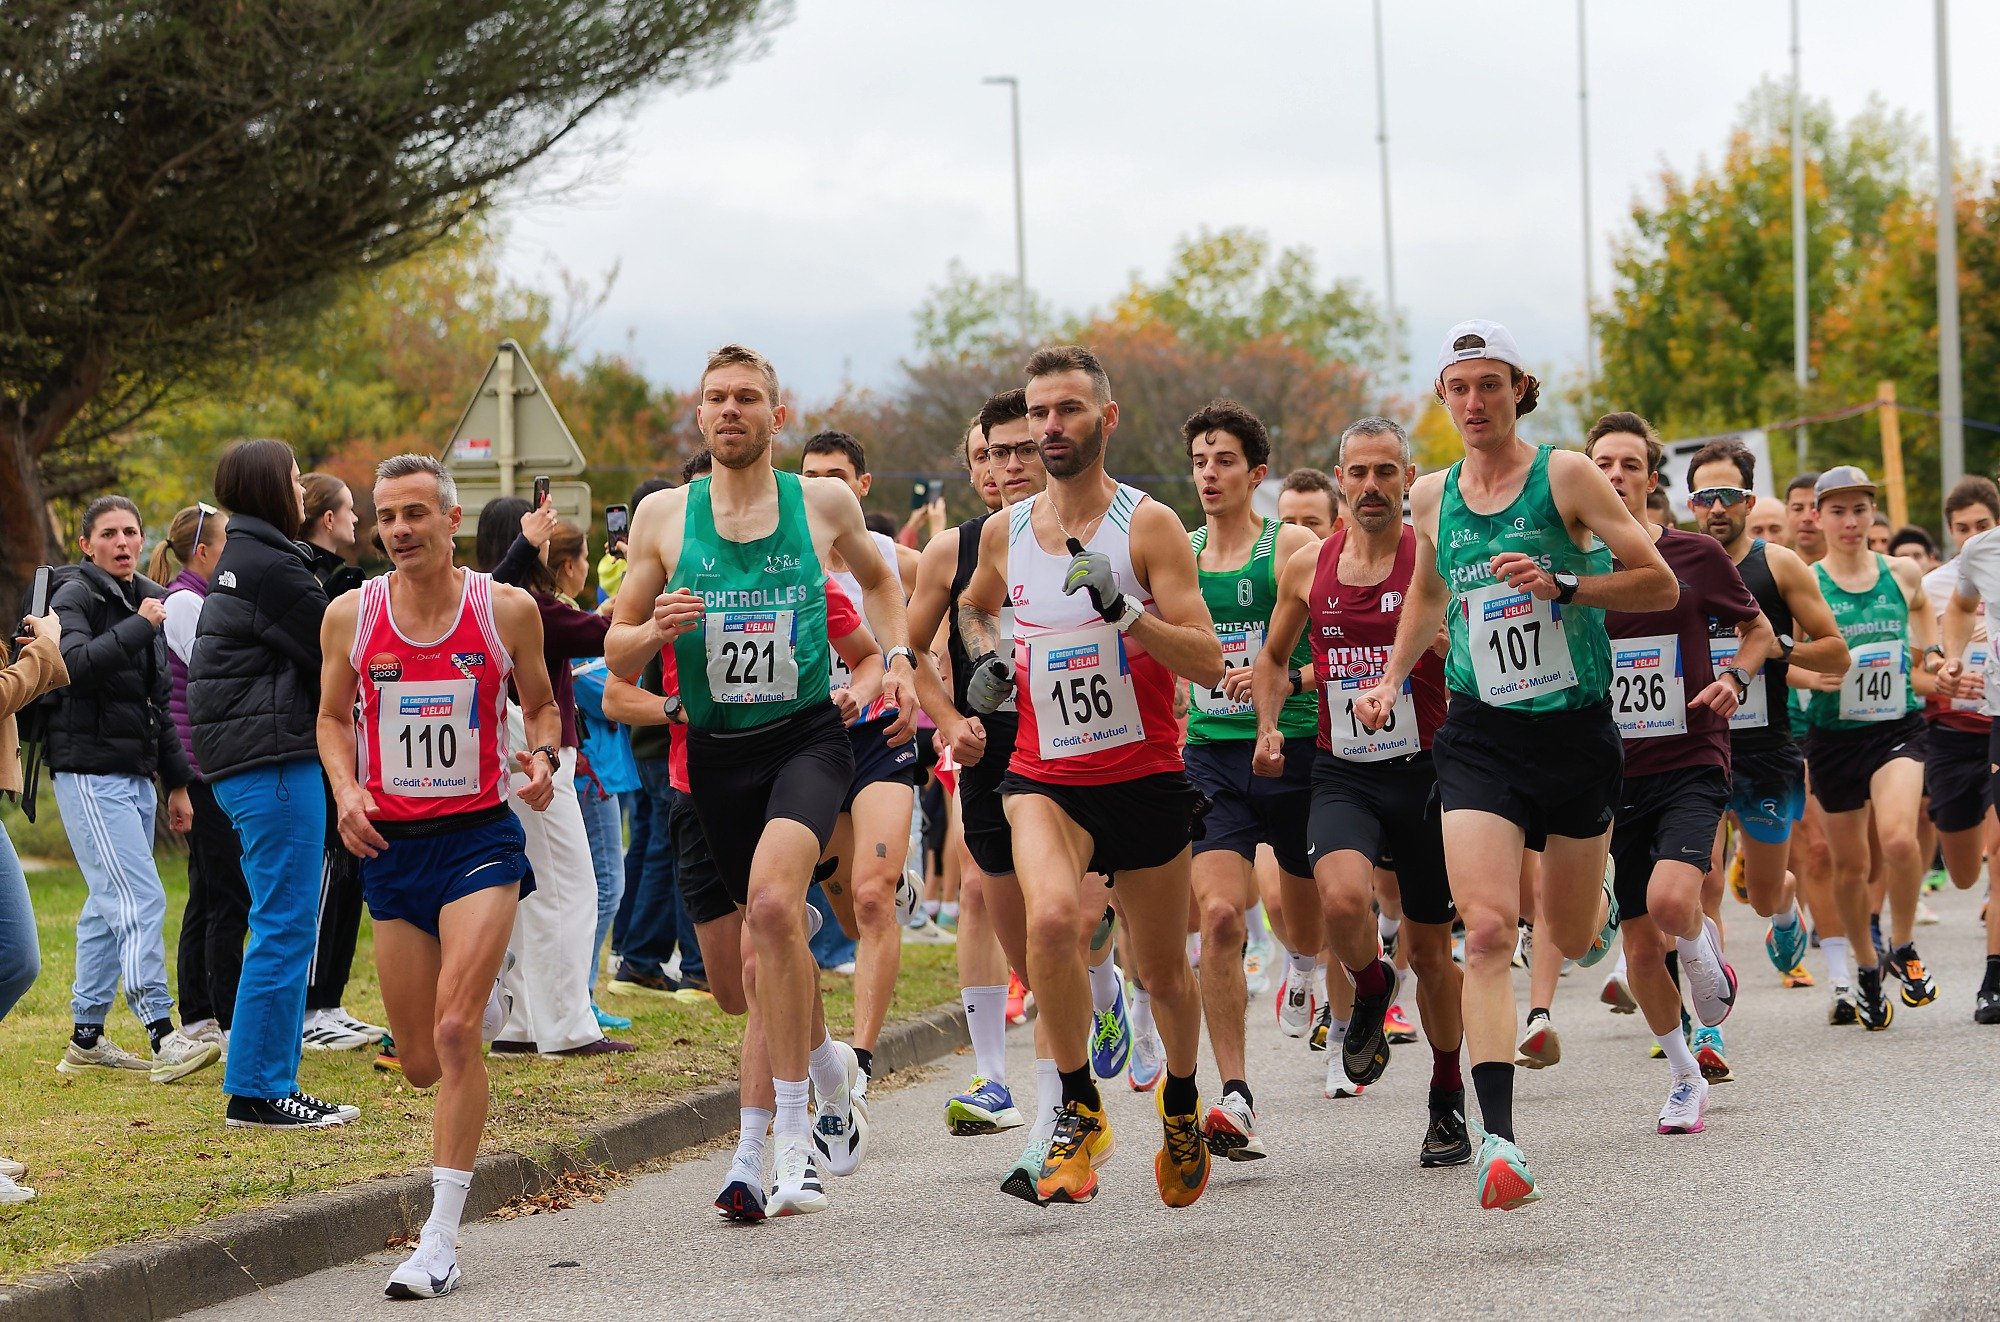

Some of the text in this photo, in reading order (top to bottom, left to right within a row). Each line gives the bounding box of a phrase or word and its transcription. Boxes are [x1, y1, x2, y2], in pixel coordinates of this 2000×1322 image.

[1491, 600, 1509, 609] CRÉDIT
[1510, 594, 1531, 605] MUTUEL
[1485, 603, 1531, 620] DONNE L'ÉLAN
[745, 622, 774, 632] L'ÉLAN
[1056, 650, 1074, 659] CRÉDIT
[1075, 646, 1097, 656] MUTUEL
[1223, 642, 1245, 652] L'ÉLAN
[1489, 621, 1541, 674] 107
[370, 662, 399, 671] SPORT
[722, 641, 774, 683] 221
[1049, 655, 1098, 670] DONNE L'ÉLAN
[1634, 657, 1659, 668] L'ÉLAN
[373, 670, 397, 678] 2000
[1490, 671, 1561, 696] Crédit Mutuel
[1855, 671, 1891, 702] 140
[721, 692, 784, 703] Crédit Mutuel
[1051, 674, 1113, 726] 156
[1616, 673, 1666, 713] 236
[422, 704, 451, 716] L'ÉLAN
[1206, 706, 1229, 716] Crédit
[1646, 719, 1675, 729] Mutuel
[1052, 725, 1128, 748] Crédit Mutuel
[400, 724, 456, 768] 110
[1342, 738, 1408, 756] Crédit Mutuel
[393, 777, 466, 787] Crédit Mutuel
